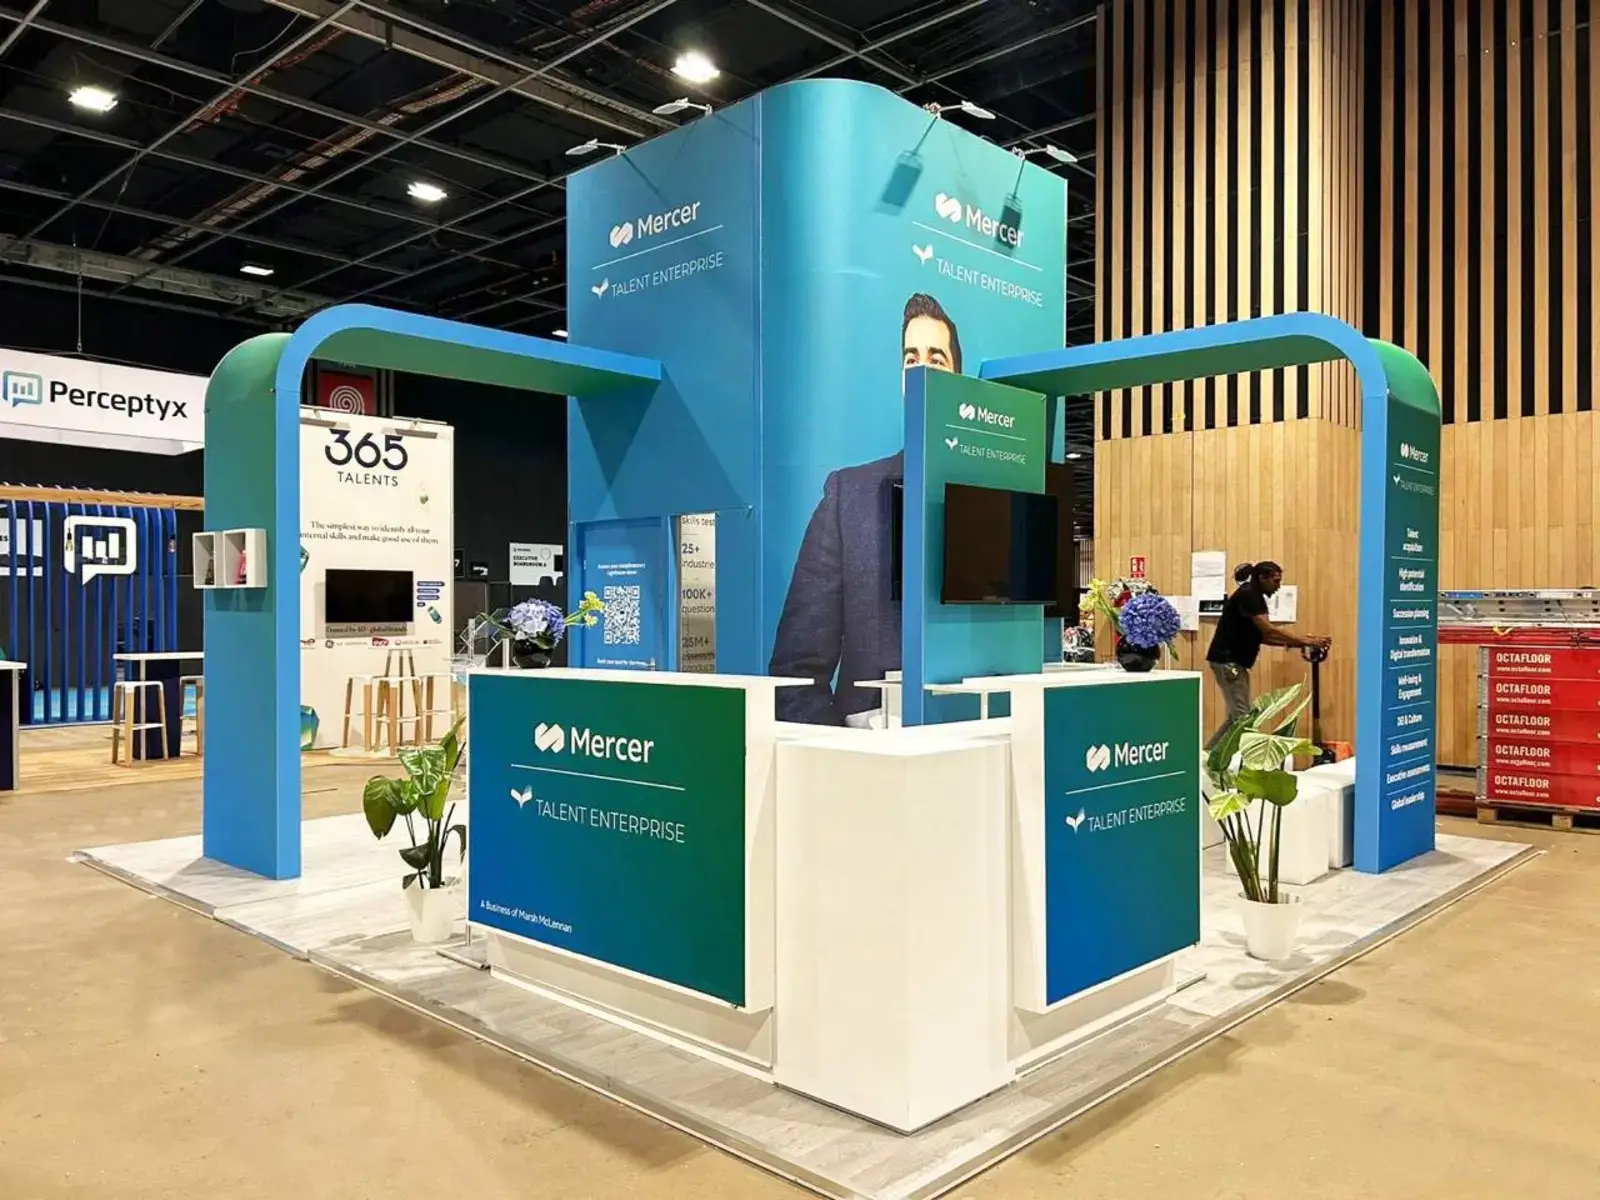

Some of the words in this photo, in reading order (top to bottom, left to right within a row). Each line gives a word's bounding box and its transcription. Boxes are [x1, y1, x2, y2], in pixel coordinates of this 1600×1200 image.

[638, 201, 700, 239] Mercer
[966, 204, 1024, 248] Mercer
[611, 274, 650, 298] TALENT
[653, 252, 724, 286] ENTERPRISE
[936, 258, 979, 286] TALENT
[980, 274, 1043, 308] ENTERPRISE
[50, 381, 188, 421] Perceptyx
[978, 406, 1014, 428] Mercer
[324, 428, 408, 470] 365
[960, 444, 984, 458] TALENT
[986, 448, 1026, 466] ENTERPRISE
[337, 471, 399, 487] TALENTS
[310, 520, 325, 530] The
[682, 543, 700, 554] 25+
[682, 588, 712, 600] 100K+
[1496, 652, 1552, 664] OCTAFLOOR
[1496, 683, 1551, 695] OCTAFLOOR
[1495, 714, 1551, 726] OCTAFLOOR
[570, 726, 654, 764] Mercer
[1114, 741, 1169, 768] Mercer
[1495, 744, 1550, 758] OCTAFLOOR
[1494, 775, 1550, 789] OCTAFLOOR
[536, 799, 587, 826] TALENT
[590, 808, 686, 844] ENTERPRISE
[1088, 810, 1128, 832] TALENT
[1129, 797, 1186, 824] ENTERPRISE
[480, 900, 486, 908] A
[486, 900, 510, 916] Business
[511, 908, 518, 918] of
[519, 910, 538, 924] Marsh
[538, 915, 572, 934] McLennan
